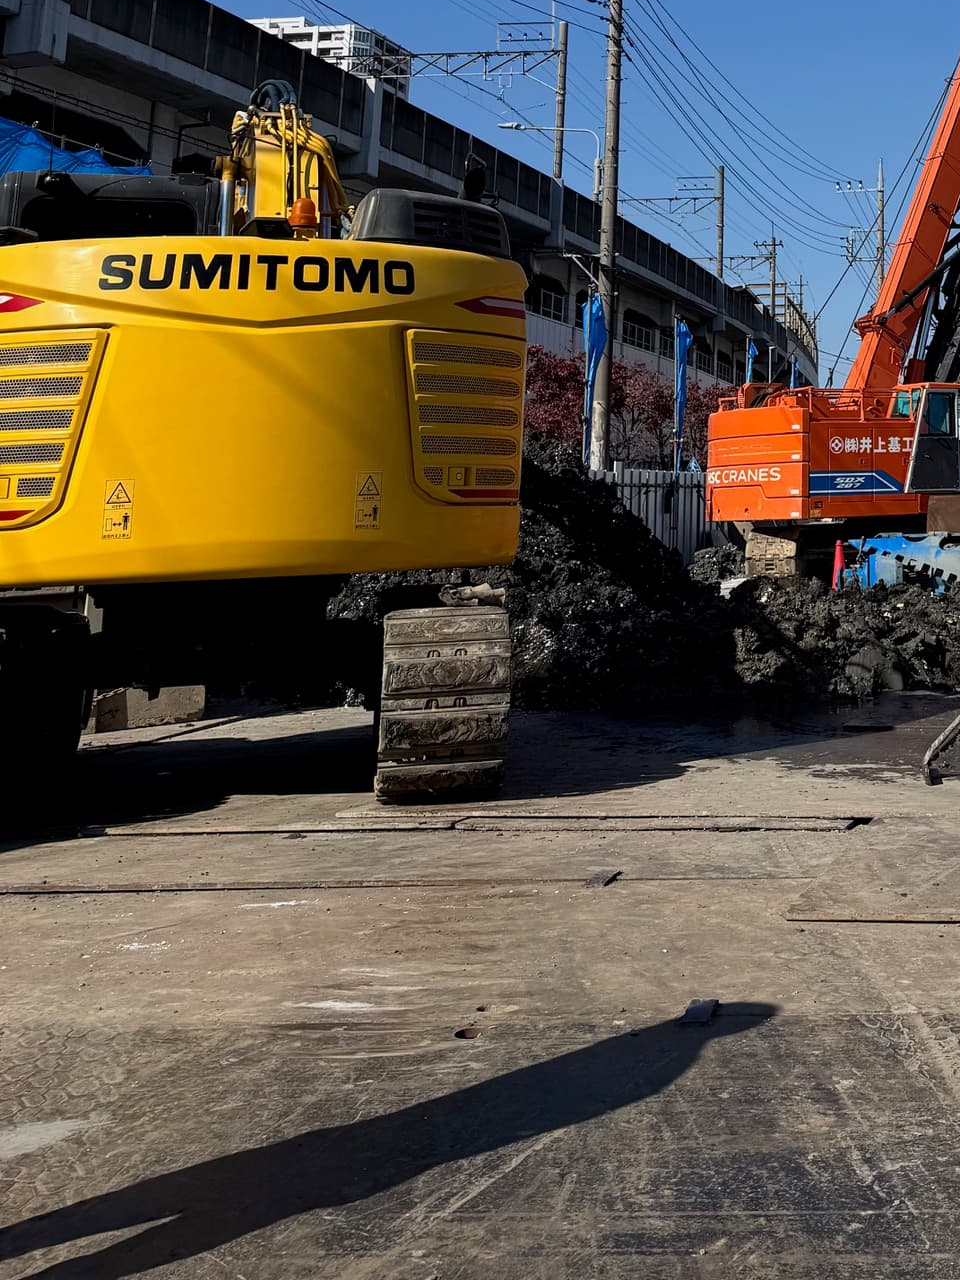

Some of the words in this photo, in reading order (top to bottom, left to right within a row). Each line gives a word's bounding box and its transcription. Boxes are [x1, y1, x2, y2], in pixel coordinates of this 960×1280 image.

[98, 253, 416, 296] SUMITOMO
[722, 467, 781, 484] CRANES
[833, 476, 866, 484] SDX
